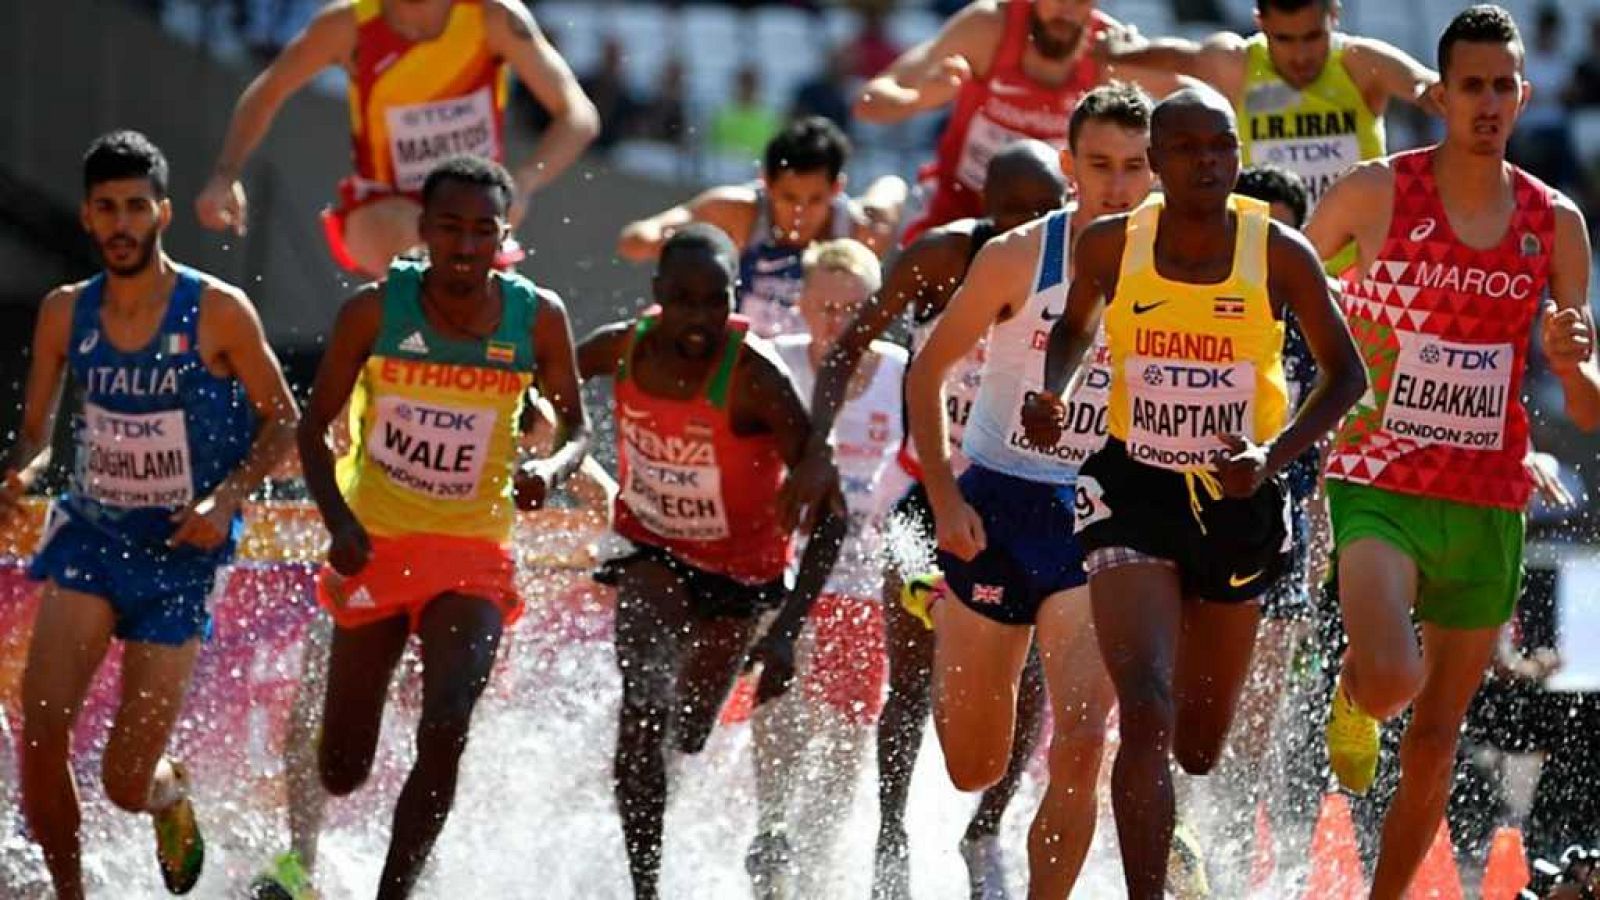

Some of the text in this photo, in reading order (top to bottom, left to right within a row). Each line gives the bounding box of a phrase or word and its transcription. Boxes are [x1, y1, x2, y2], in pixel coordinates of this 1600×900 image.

[1287, 141, 1343, 162] TDK
[1414, 261, 1533, 300] MAROC
[1135, 328, 1235, 363] UGANDA
[1442, 347, 1500, 370] TDK
[87, 366, 179, 395] ITALIA
[1164, 366, 1236, 388] TDK
[1393, 374, 1504, 418] ELBAKKALI
[109, 418, 164, 438] TDK
[416, 407, 478, 431] TDK
[1132, 397, 1248, 438] ARAPTANY
[1385, 417, 1499, 446] LONDON 2017
[384, 421, 476, 473] WALE
[1131, 441, 1205, 465] LONDON
